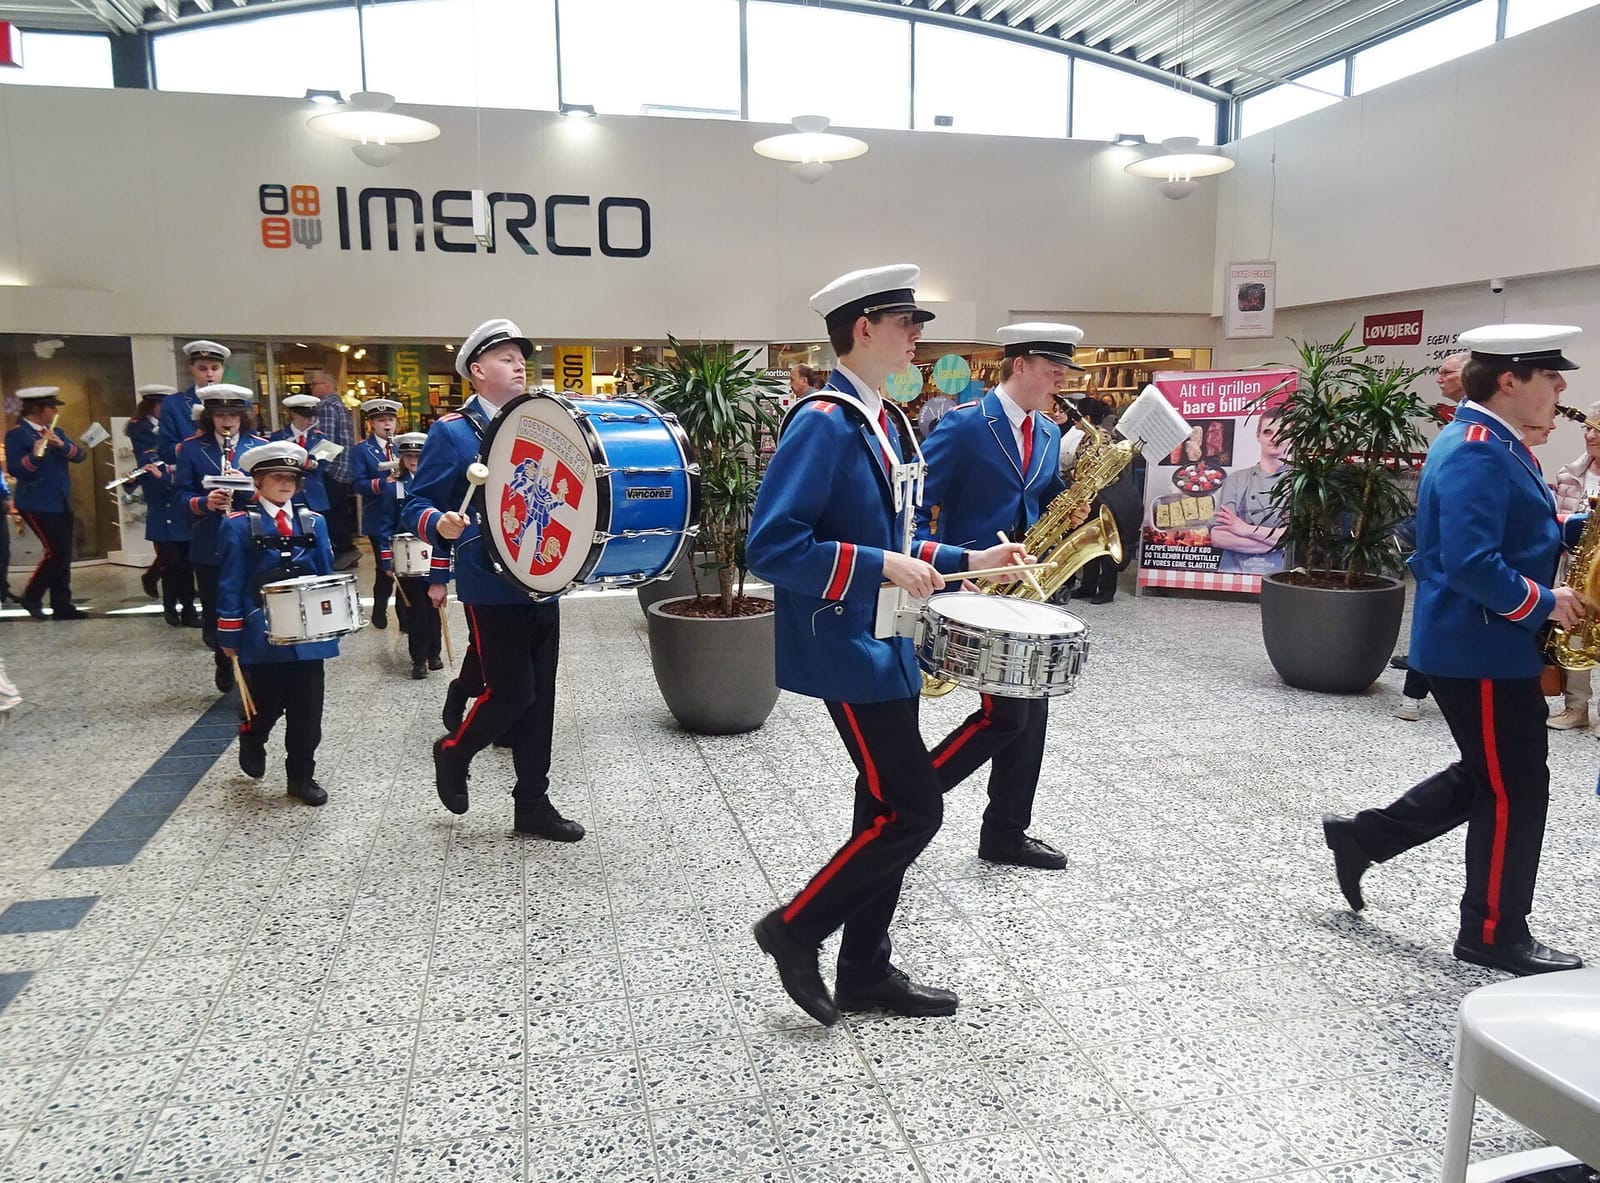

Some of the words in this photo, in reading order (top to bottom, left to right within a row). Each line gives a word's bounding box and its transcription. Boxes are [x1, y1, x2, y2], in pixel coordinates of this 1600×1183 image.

[336, 186, 651, 258] IMERCO
[1366, 322, 1419, 339] LØVBJERG
[1427, 334, 1450, 345] EGEN
[1364, 354, 1386, 365] ALTID
[563, 354, 584, 393] UDS
[1180, 383, 1197, 398] Alt
[1201, 382, 1214, 396] til
[1219, 380, 1260, 400] grillen
[1183, 400, 1215, 414] bare
[523, 419, 551, 436] ODENSE
[576, 453, 586, 467] OG
[1167, 545, 1189, 553] UDVALG
[1181, 553, 1220, 562] FREMSTILLET
[1188, 562, 1218, 570] SLAGTERE
